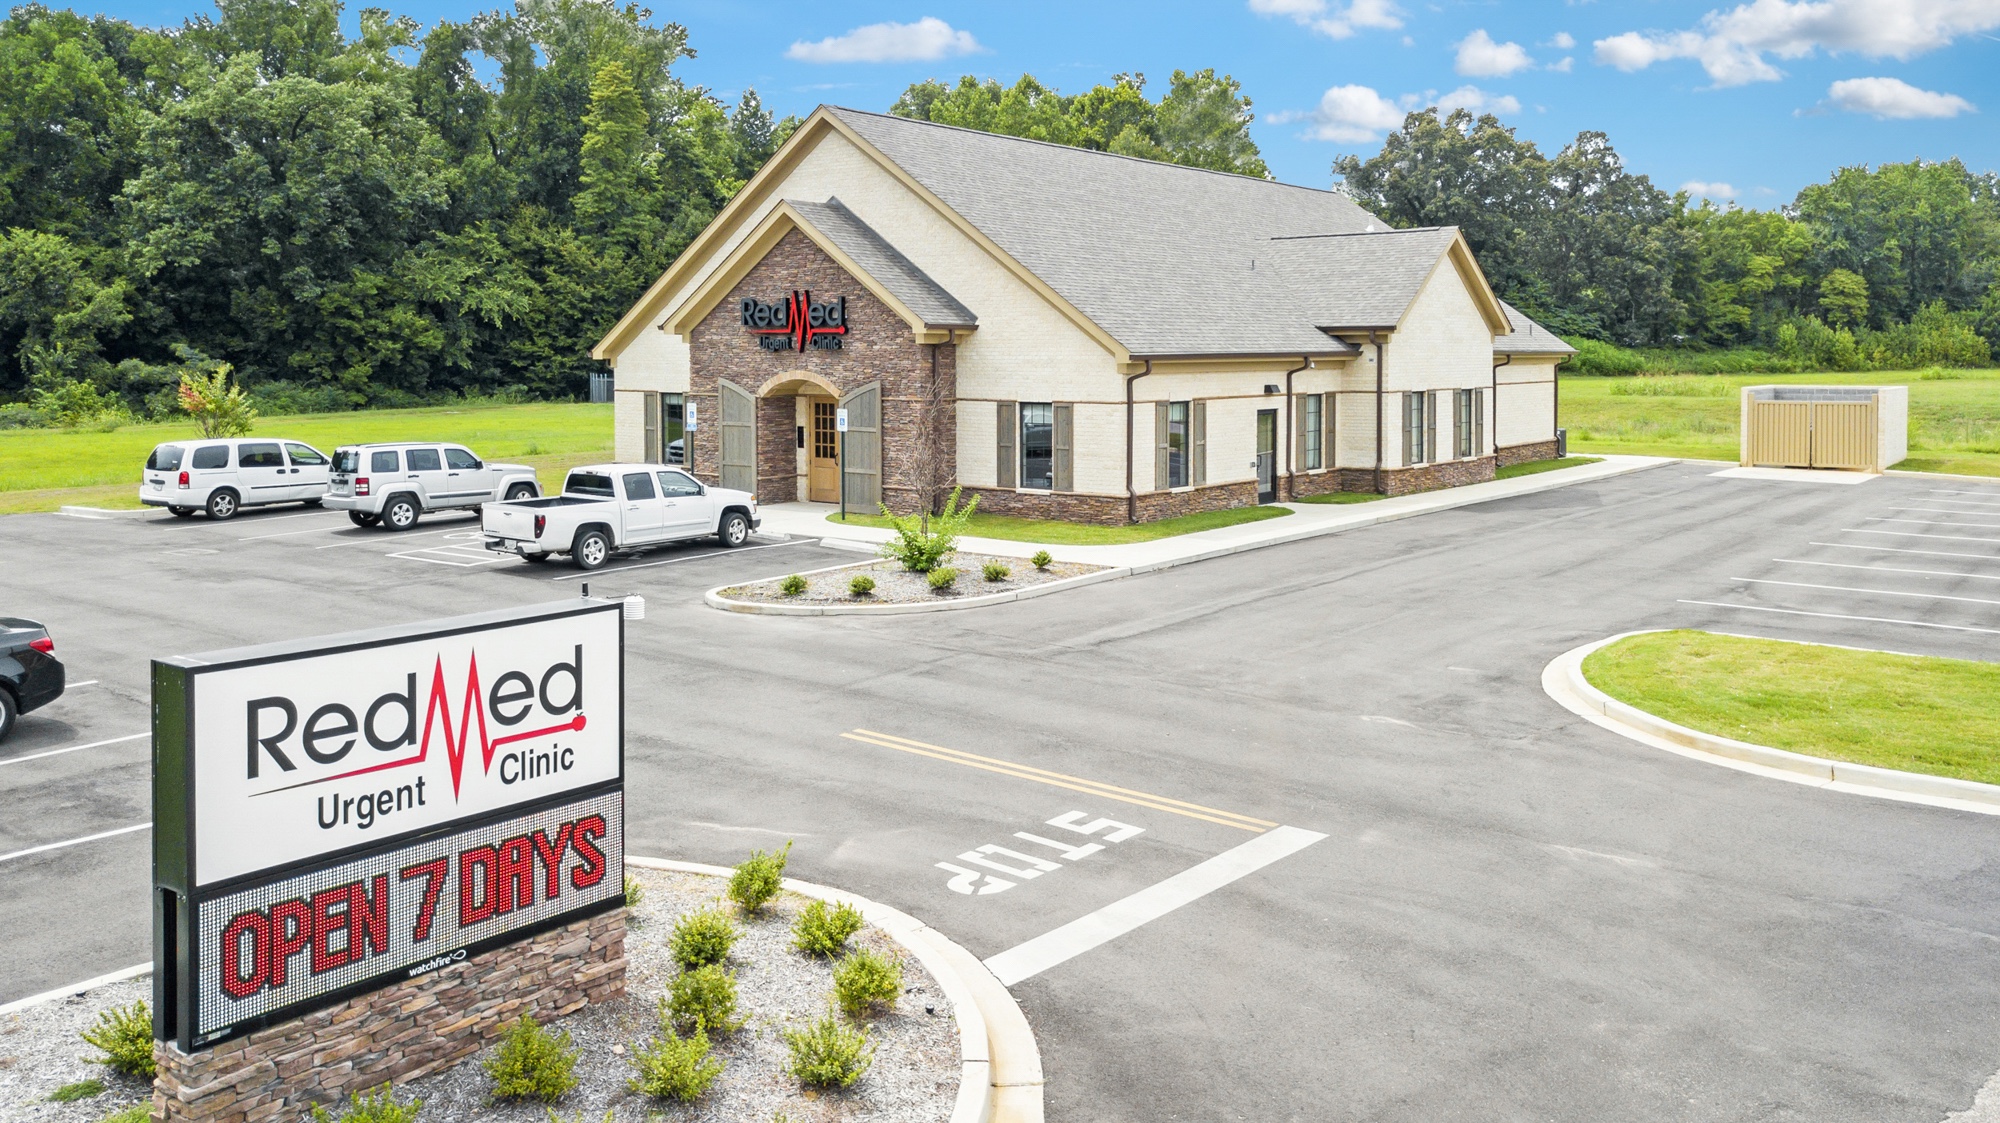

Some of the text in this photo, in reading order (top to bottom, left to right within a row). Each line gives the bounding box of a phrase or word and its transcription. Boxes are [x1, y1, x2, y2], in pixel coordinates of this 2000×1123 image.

[741, 290, 846, 352] RedMed
[760, 335, 842, 352] Urgent Clinic
[246, 645, 584, 803] RedMed
[317, 743, 575, 830] Urgent Clinic
[934, 810, 1147, 895] STOP
[221, 813, 607, 999] OPEN 7 DAYS
[409, 957, 451, 977] watchfire
